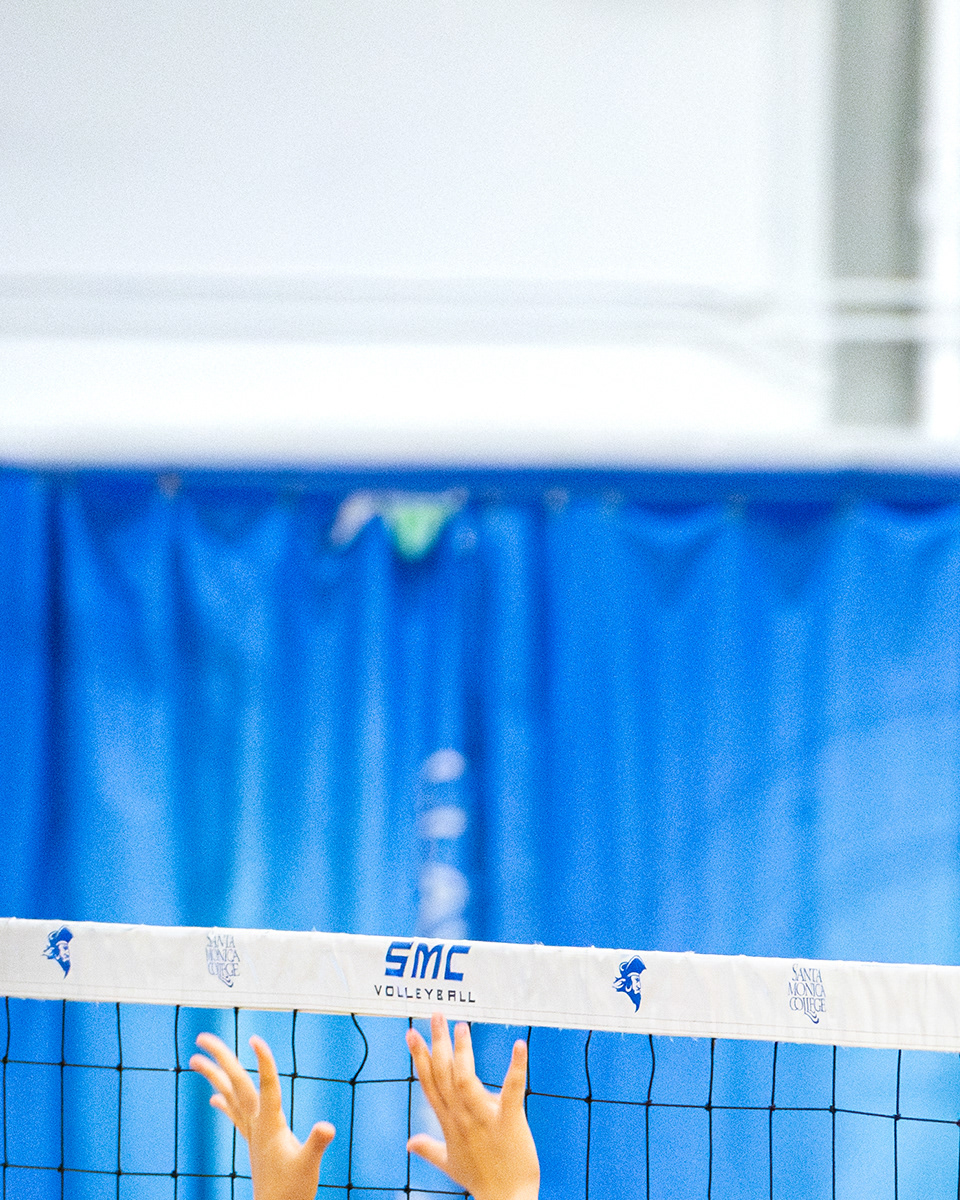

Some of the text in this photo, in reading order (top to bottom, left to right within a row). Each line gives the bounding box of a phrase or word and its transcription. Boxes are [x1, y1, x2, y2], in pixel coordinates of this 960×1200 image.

[384, 941, 472, 982] SMC
[791, 963, 823, 983] SANTA
[373, 984, 476, 1003] VOLLEYBALL
[787, 981, 827, 998] MONICA
[789, 996, 827, 1025] COLLEGE
